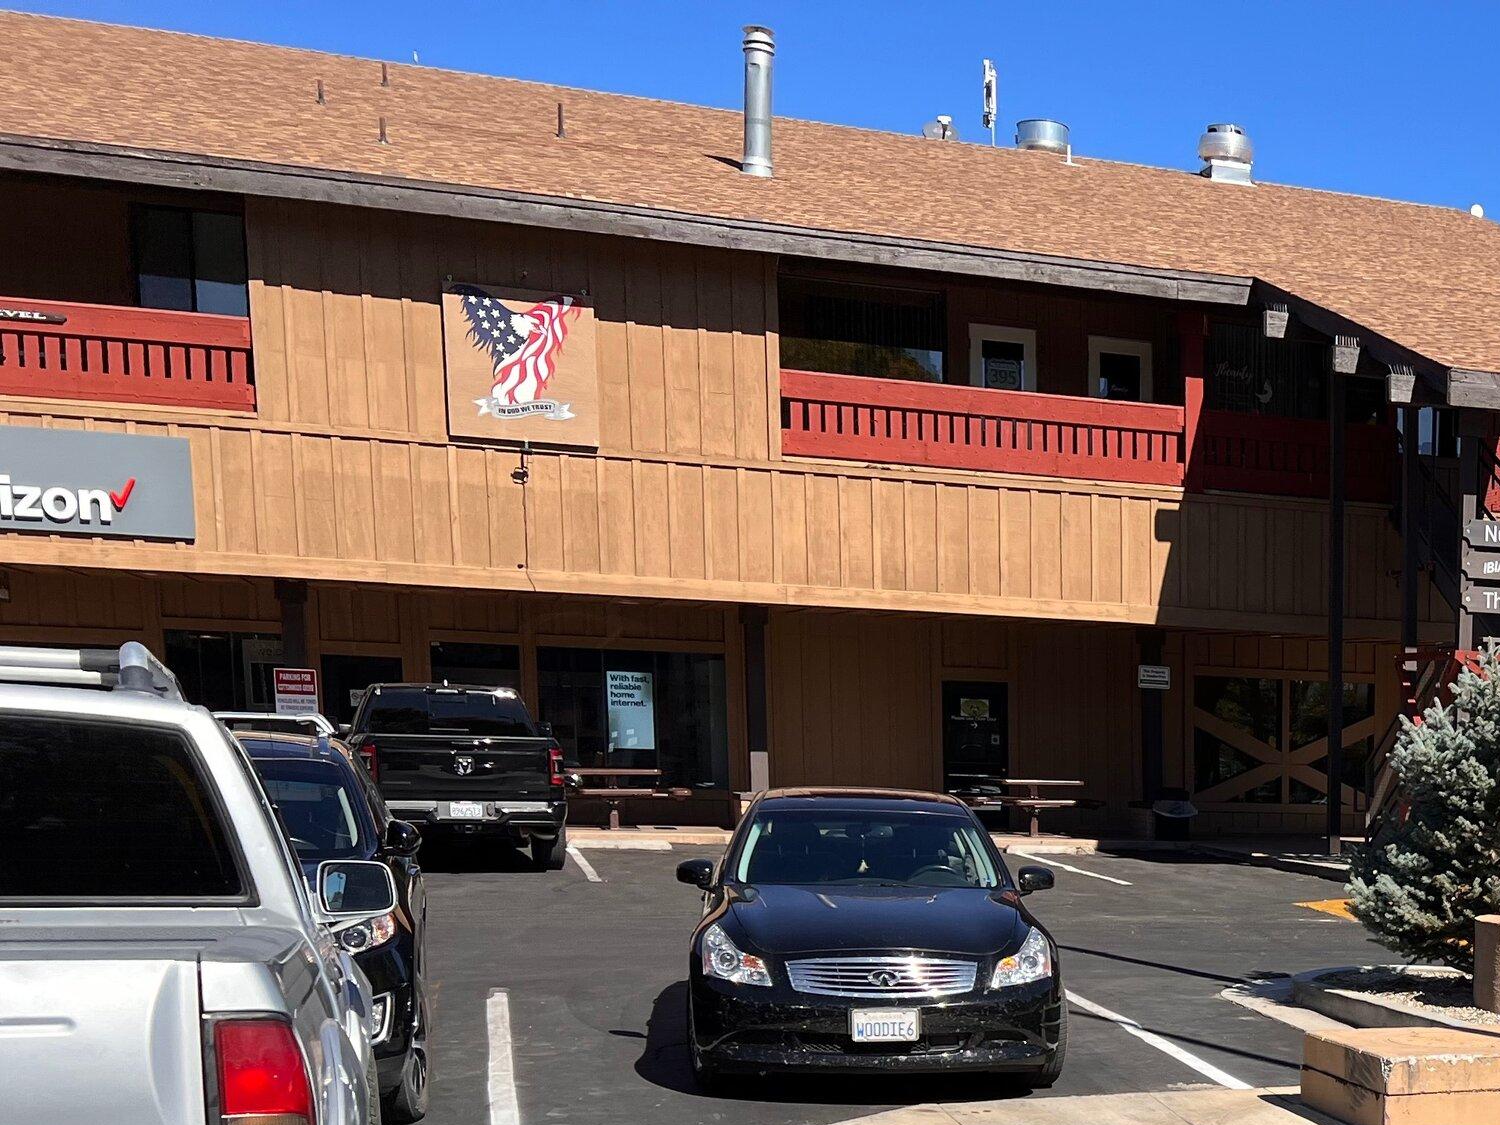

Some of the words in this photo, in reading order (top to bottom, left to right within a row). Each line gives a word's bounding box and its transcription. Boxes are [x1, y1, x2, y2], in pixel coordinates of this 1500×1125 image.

[0, 309, 47, 320] VEL
[990, 368, 1017, 385] 395
[498, 407, 506, 415] IN
[507, 407, 520, 415] GOD
[531, 403, 552, 411] TRUST
[301, 673, 311, 682] FOR
[609, 674, 630, 682] With
[631, 675, 650, 684] fast,
[610, 683, 642, 691] reliable
[610, 691, 635, 699] home
[610, 699, 647, 707] internet.
[856, 1022, 915, 1037] WOODIE6
